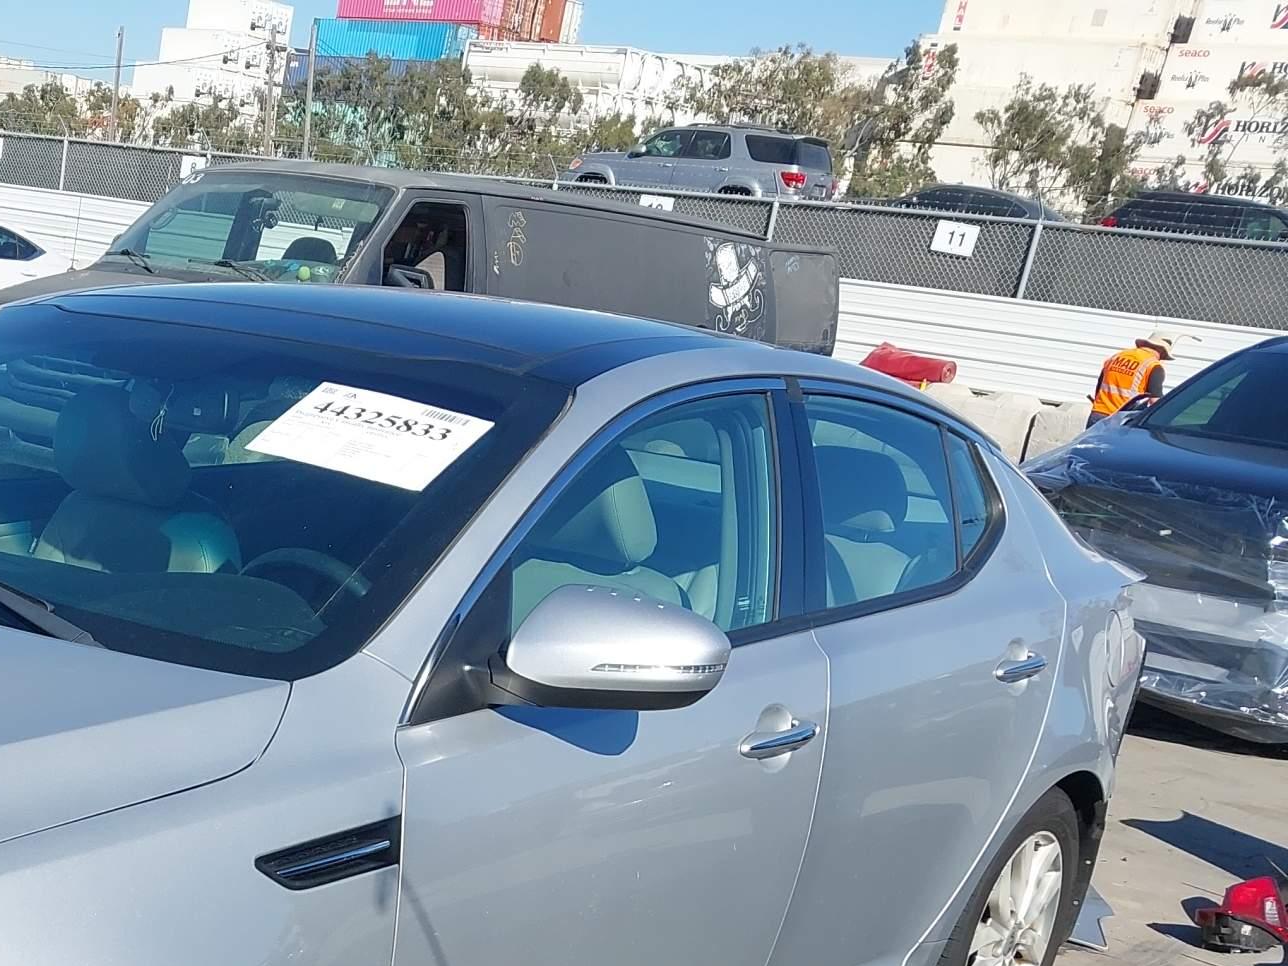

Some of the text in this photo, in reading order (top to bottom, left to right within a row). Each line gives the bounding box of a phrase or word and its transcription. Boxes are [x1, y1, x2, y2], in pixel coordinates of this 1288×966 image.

[1178, 48, 1211, 58] seaco
[948, 230, 966, 247] 11
[1112, 356, 1140, 371] MAD
[313, 401, 452, 441] 44325833
